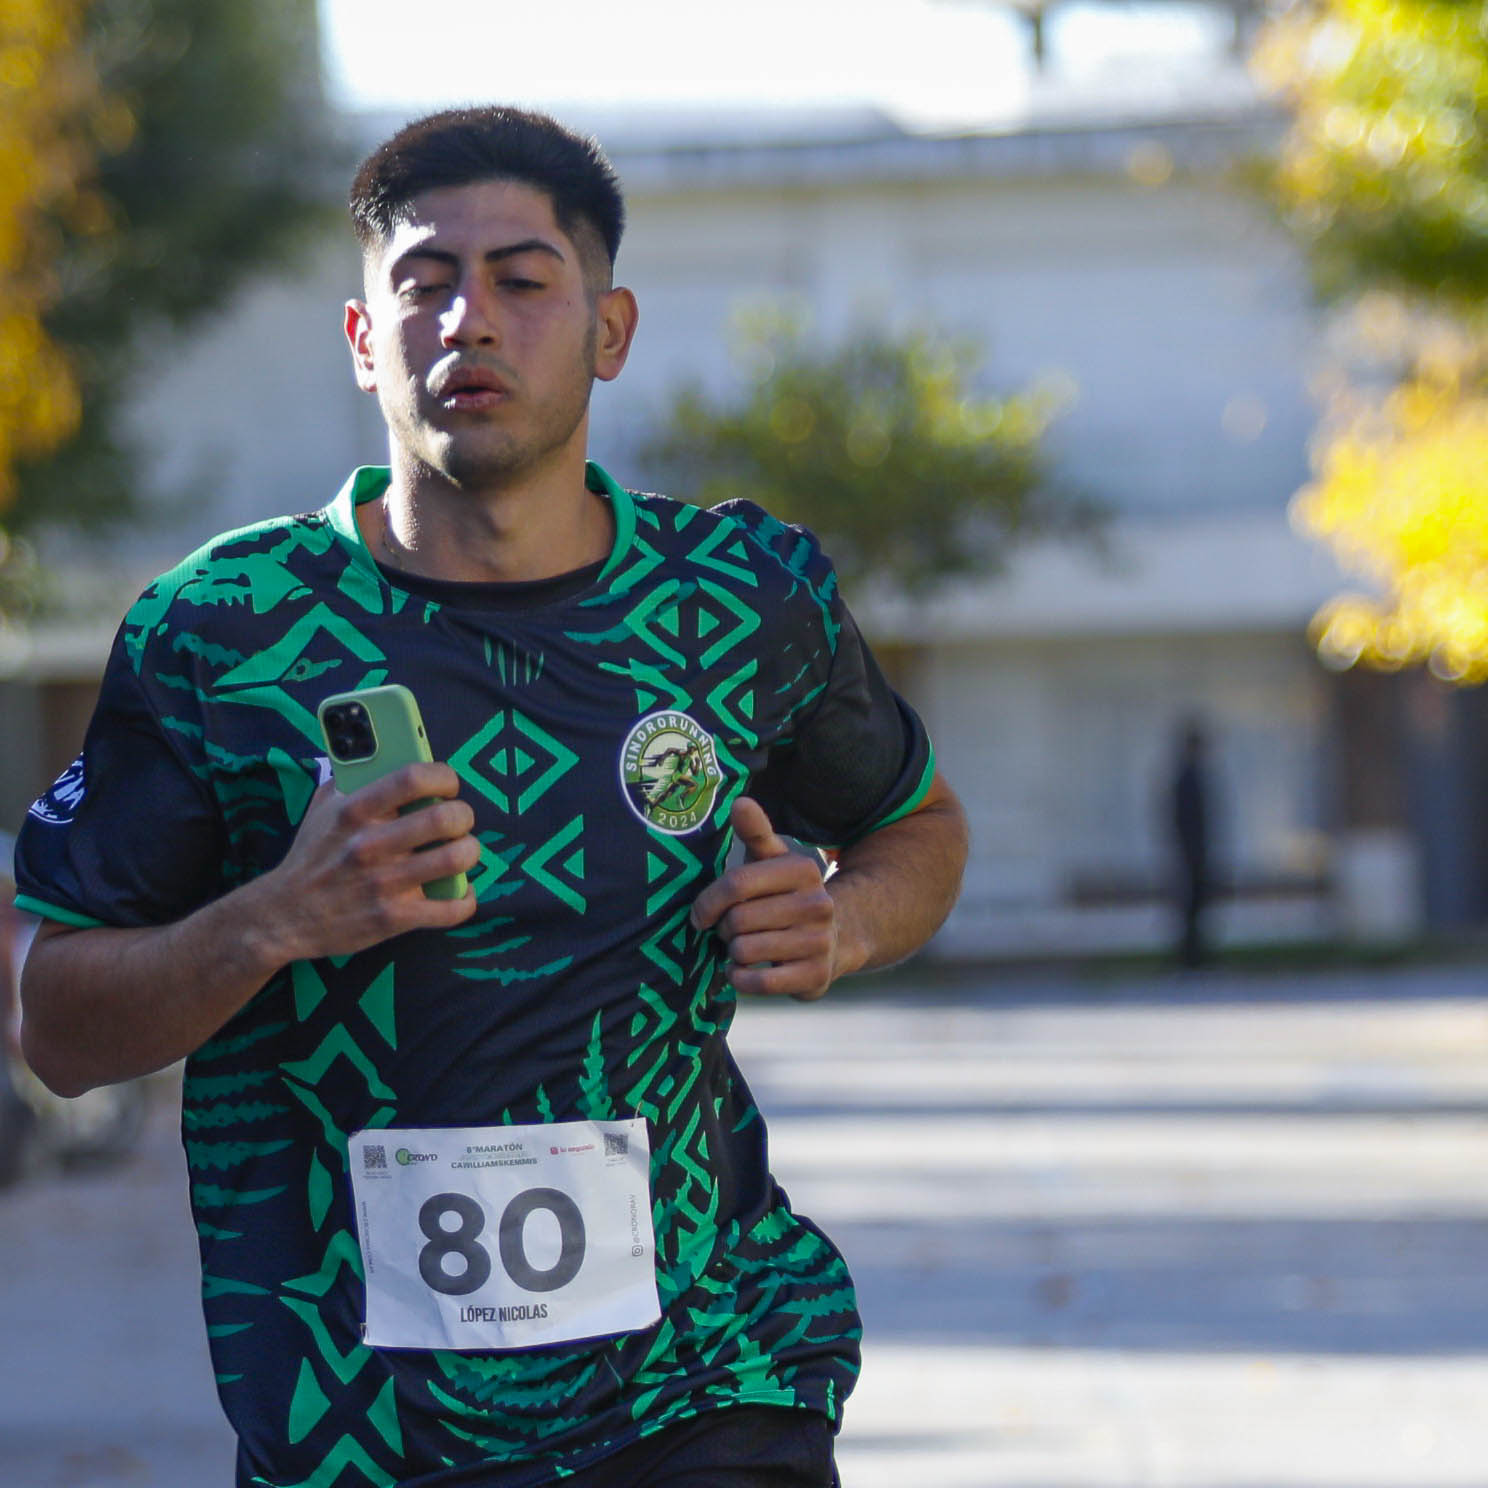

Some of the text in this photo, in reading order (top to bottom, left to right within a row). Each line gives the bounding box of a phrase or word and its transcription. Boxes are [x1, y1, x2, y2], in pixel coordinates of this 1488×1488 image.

[659, 812, 696, 829] 2024
[418, 1187, 587, 1296] 80
[460, 1303, 549, 1323] LÓPEZ NICOLAS
